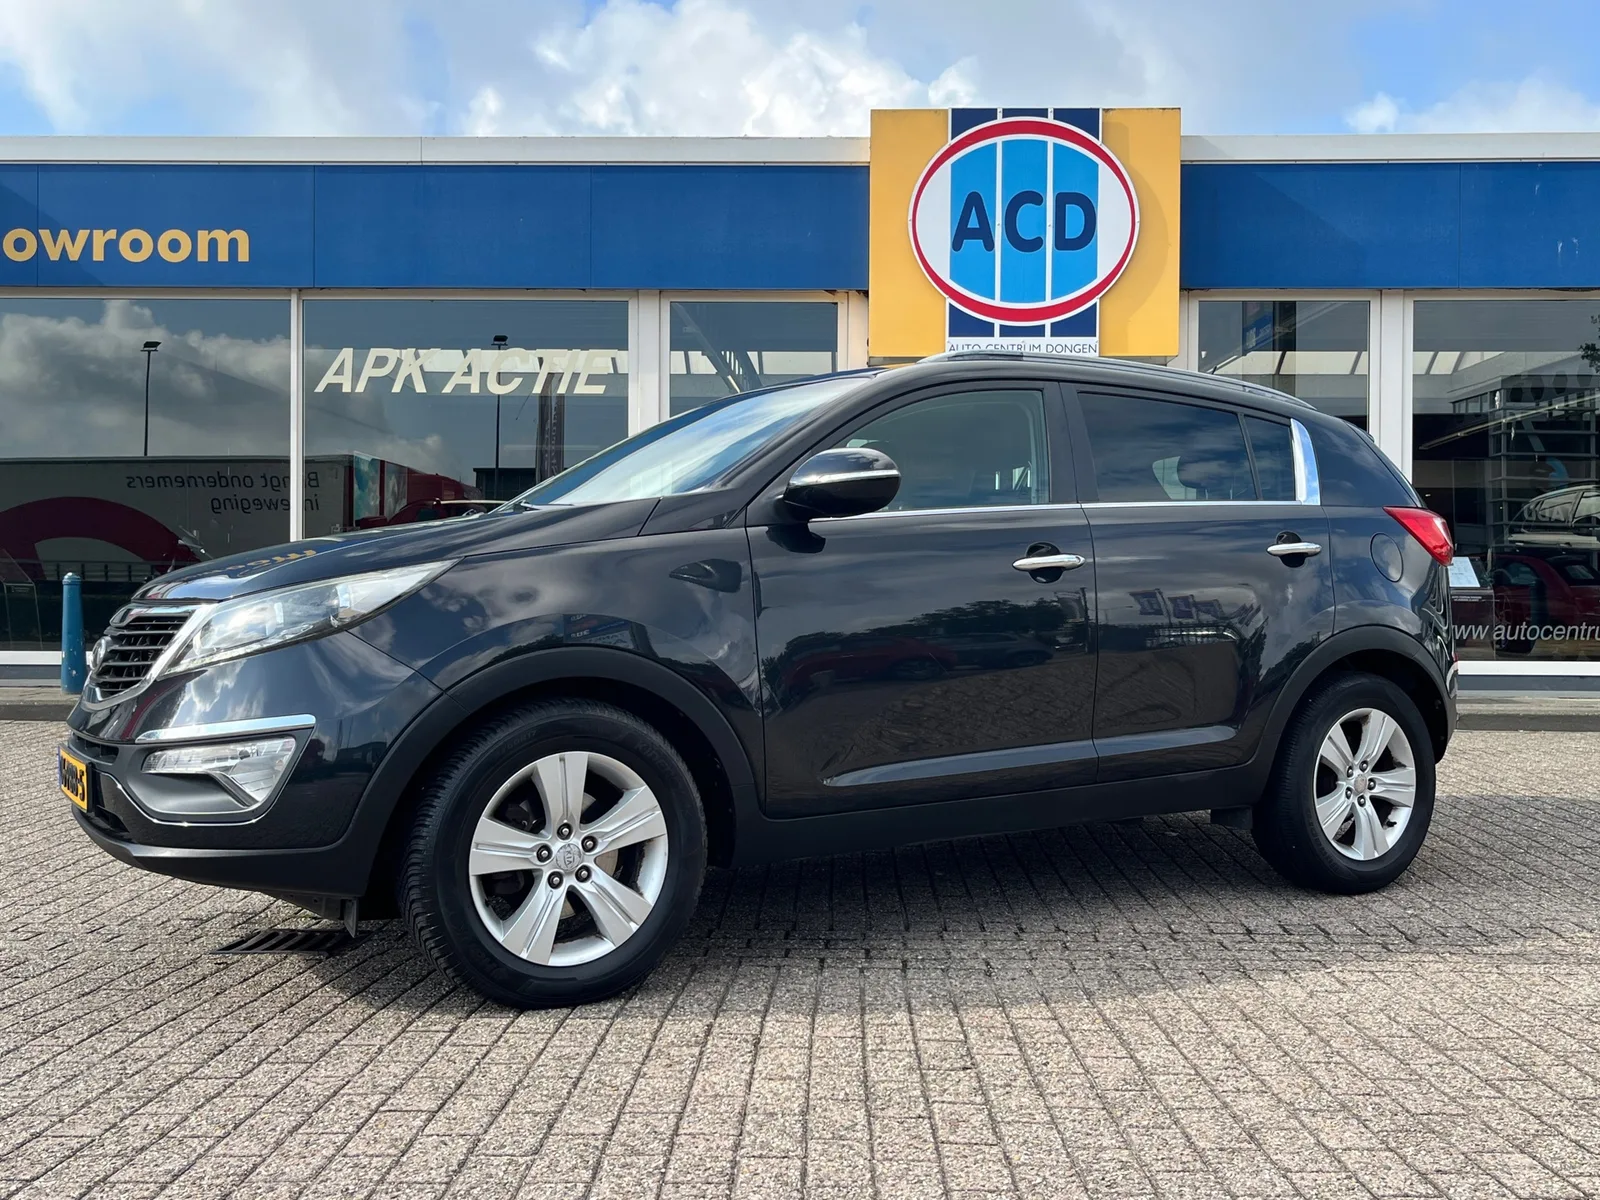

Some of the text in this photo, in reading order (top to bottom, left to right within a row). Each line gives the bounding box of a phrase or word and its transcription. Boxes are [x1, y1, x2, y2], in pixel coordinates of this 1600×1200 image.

[952, 190, 1097, 252] ACD
[2, 228, 249, 262] owroom
[1046, 343, 1097, 354] DONGEN
[314, 347, 619, 395] APK ACTIE
[1452, 624, 1490, 640] ww
